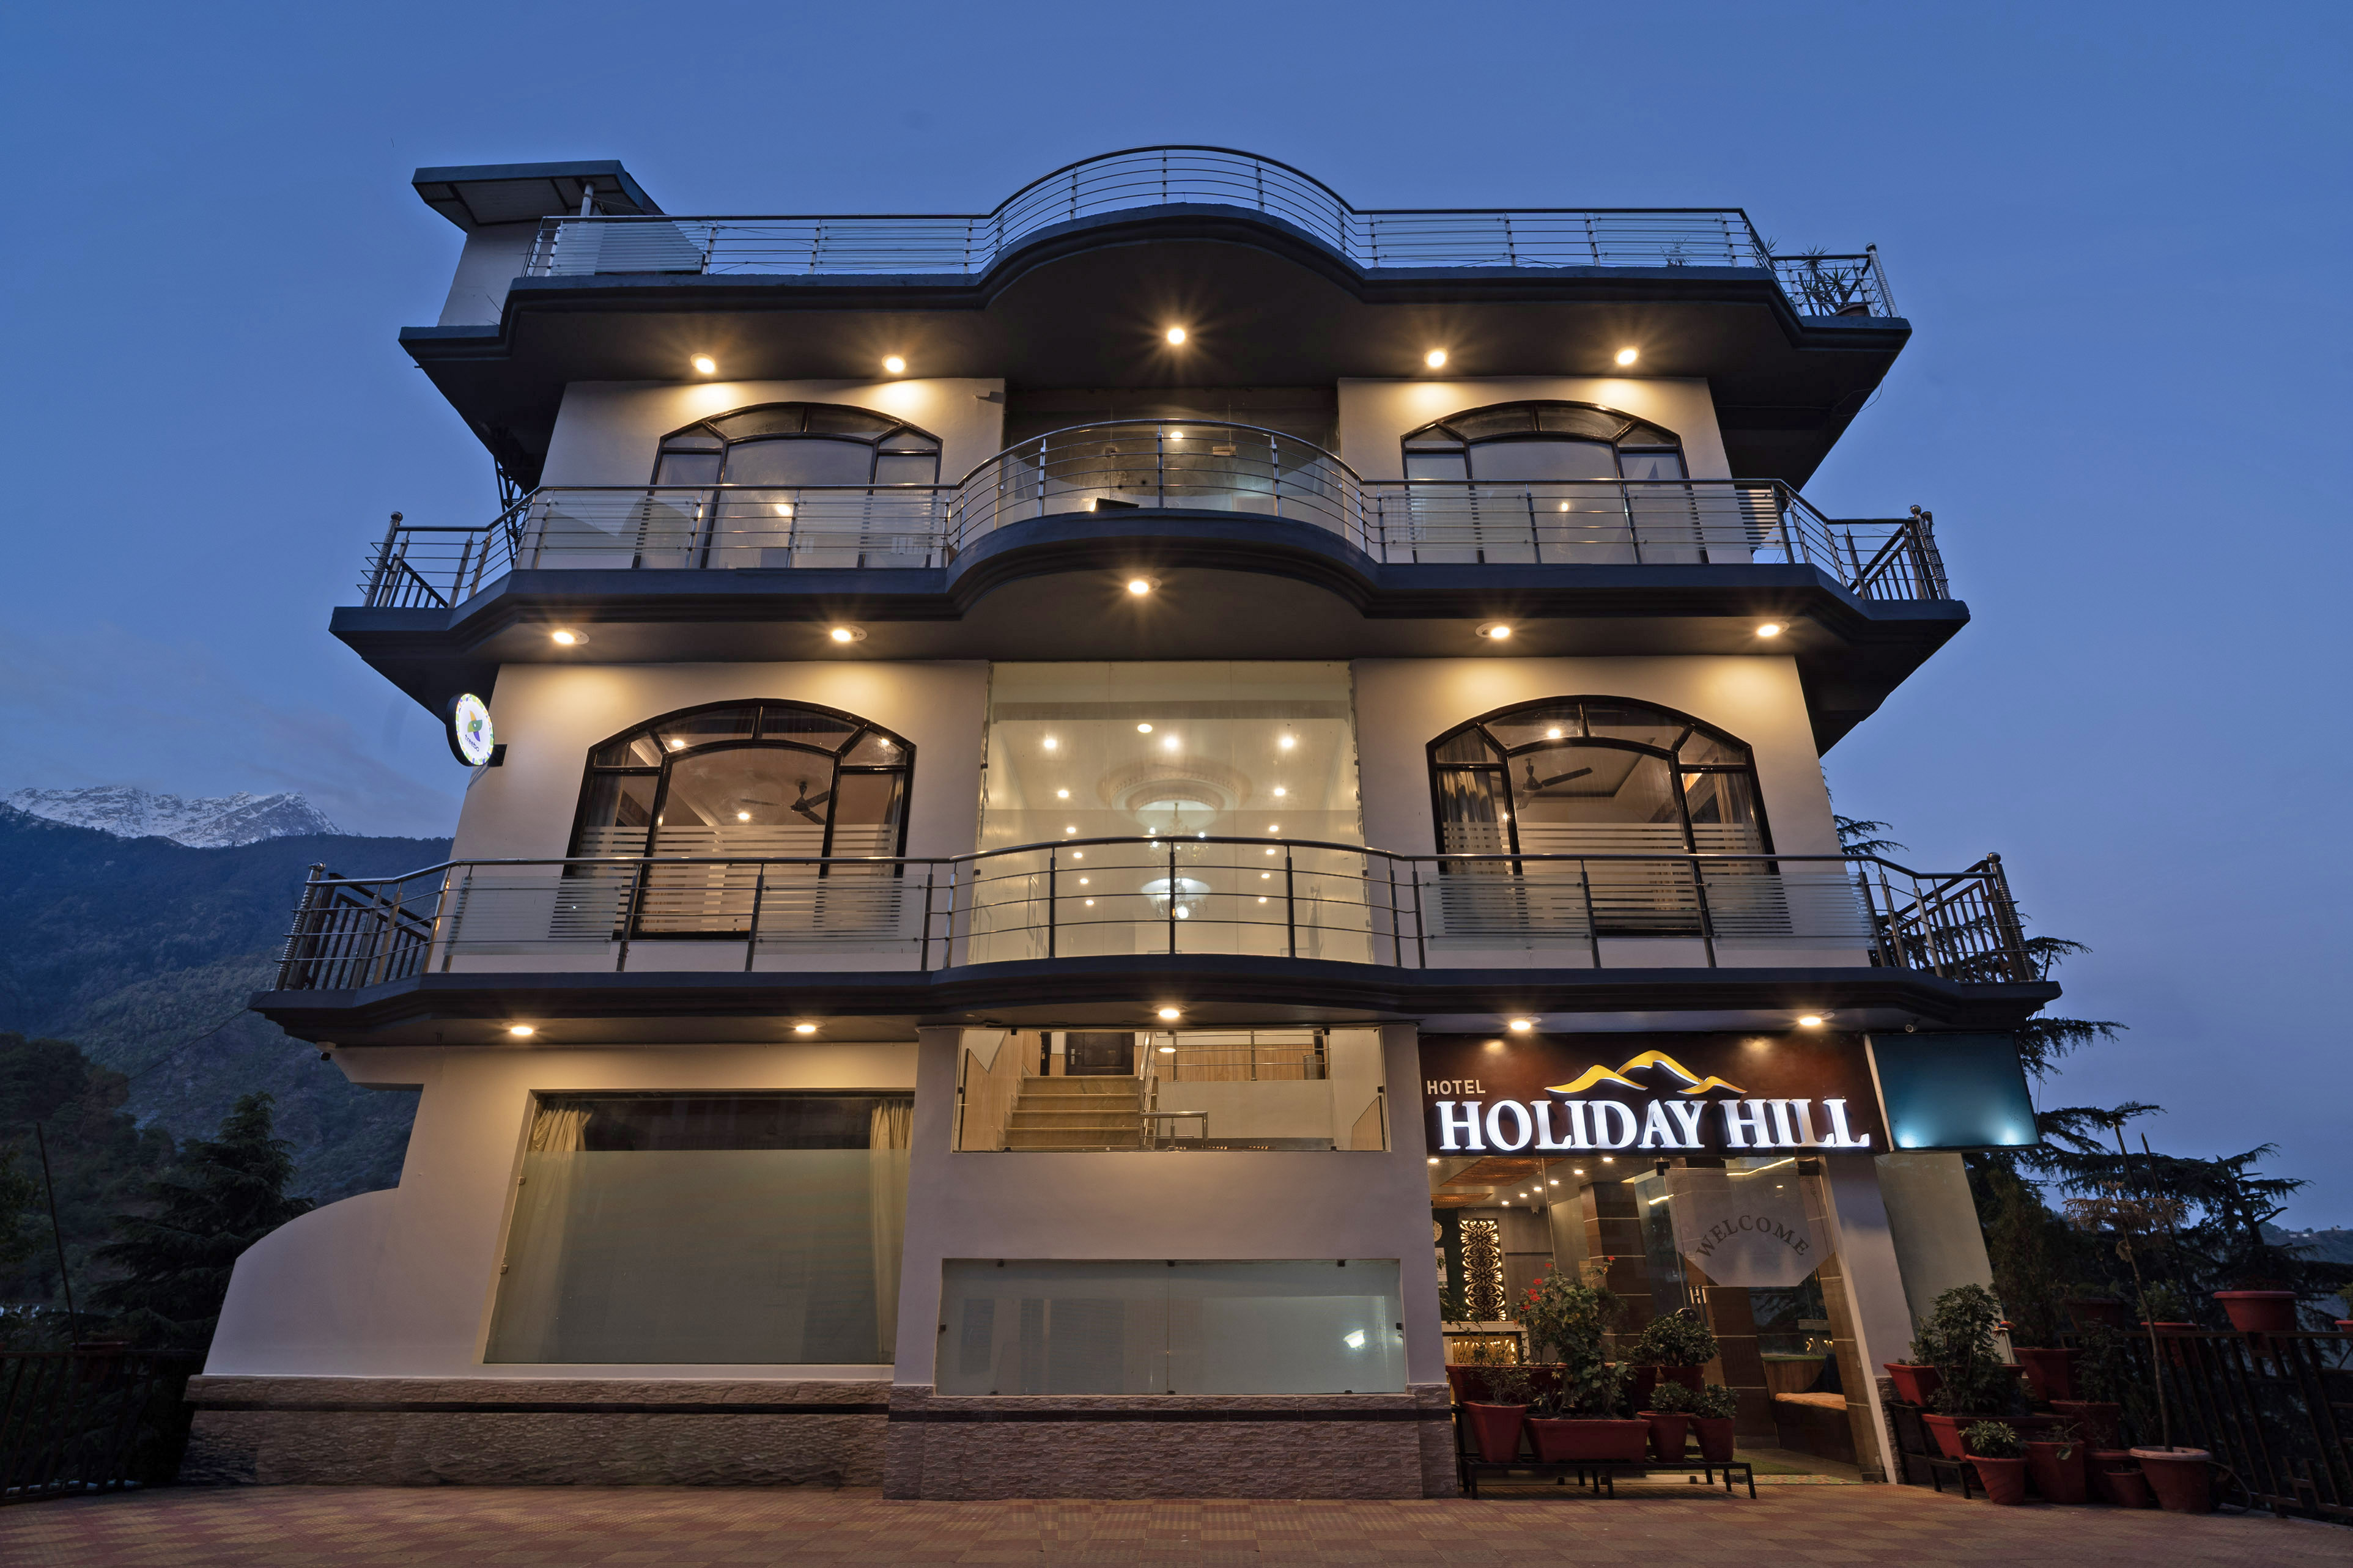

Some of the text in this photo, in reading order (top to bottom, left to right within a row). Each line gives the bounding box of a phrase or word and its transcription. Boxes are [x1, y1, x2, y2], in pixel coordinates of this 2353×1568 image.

[465, 734, 479, 752] treebo
[1427, 1080, 1486, 1095] HOTEL
[1435, 1099, 1870, 1151] HOLIDAY HILL
[1696, 1215, 1809, 1257] WELCOME
